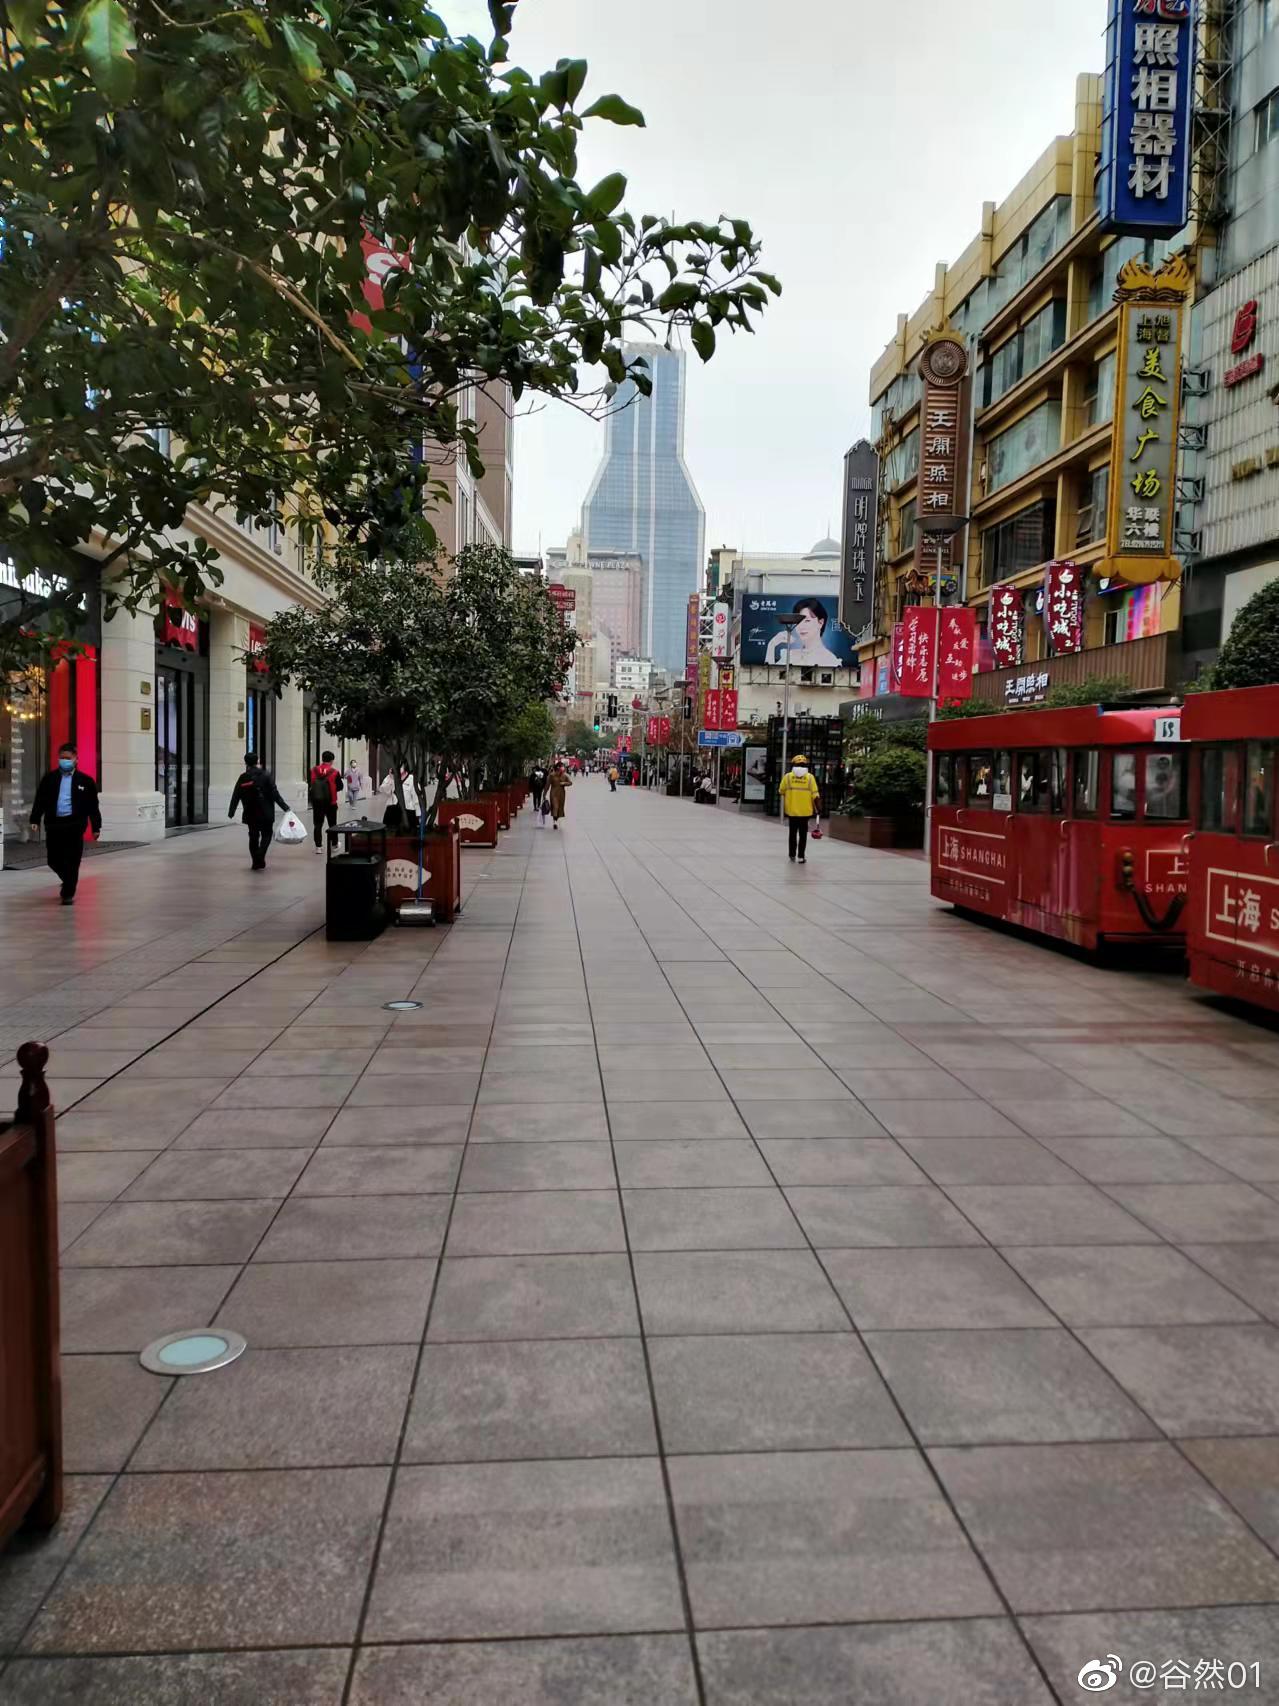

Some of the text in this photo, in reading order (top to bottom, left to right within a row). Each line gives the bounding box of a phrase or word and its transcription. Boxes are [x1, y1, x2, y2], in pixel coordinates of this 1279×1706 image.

[1131, 347, 1168, 498] 美食广场
[926, 411, 953, 508] 王開照相
[851, 495, 867, 603] 明牌珠宝
[995, 605, 1013, 654] 小吃城
[1052, 583, 1072, 638] 小吃城
[942, 834, 1006, 869] 上海 SHANGHAI
[1215, 883, 1261, 933] 上海
